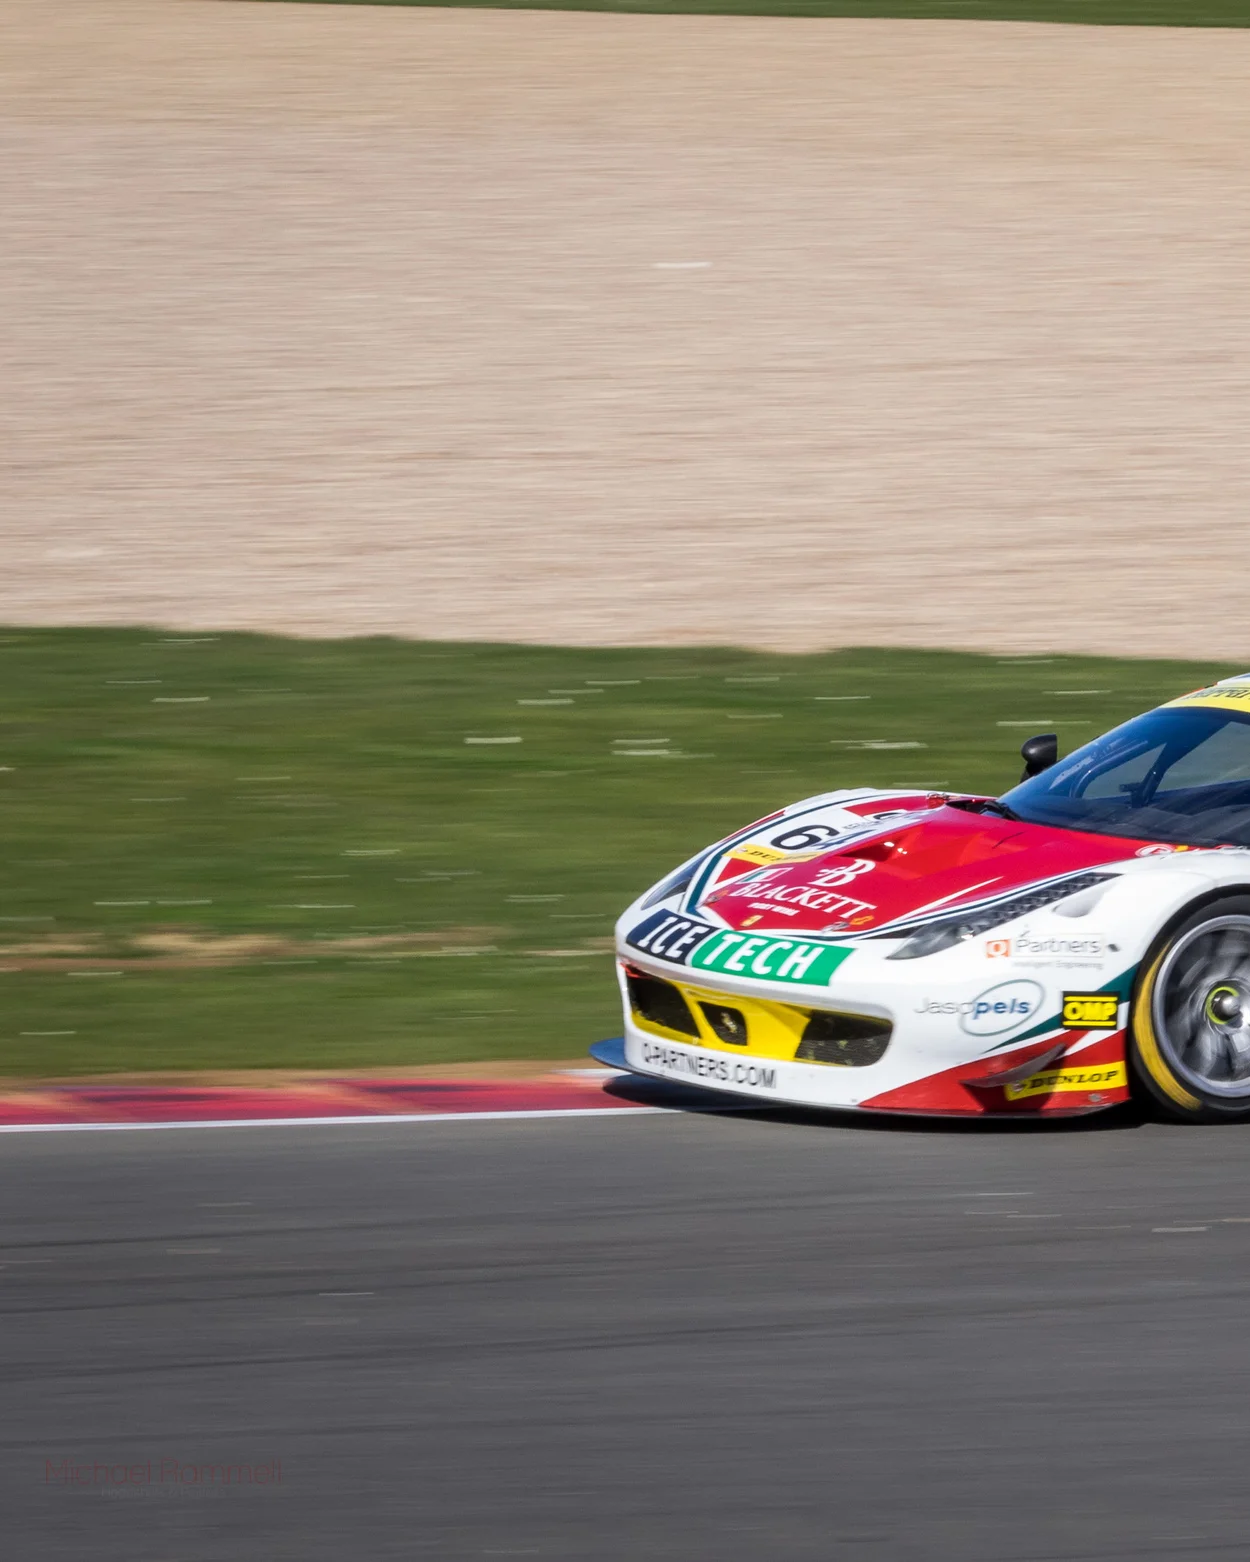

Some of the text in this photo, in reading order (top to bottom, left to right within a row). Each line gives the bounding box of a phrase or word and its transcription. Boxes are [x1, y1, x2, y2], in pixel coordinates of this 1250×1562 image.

[729, 883, 877, 919] BLACKETT
[637, 916, 825, 980] ICE TECH
[1016, 937, 1101, 954] Partners
[914, 997, 1031, 1020] Jasopels
[1063, 1001, 1118, 1021] OMP
[1029, 1070, 1119, 1089] DUNLOP
